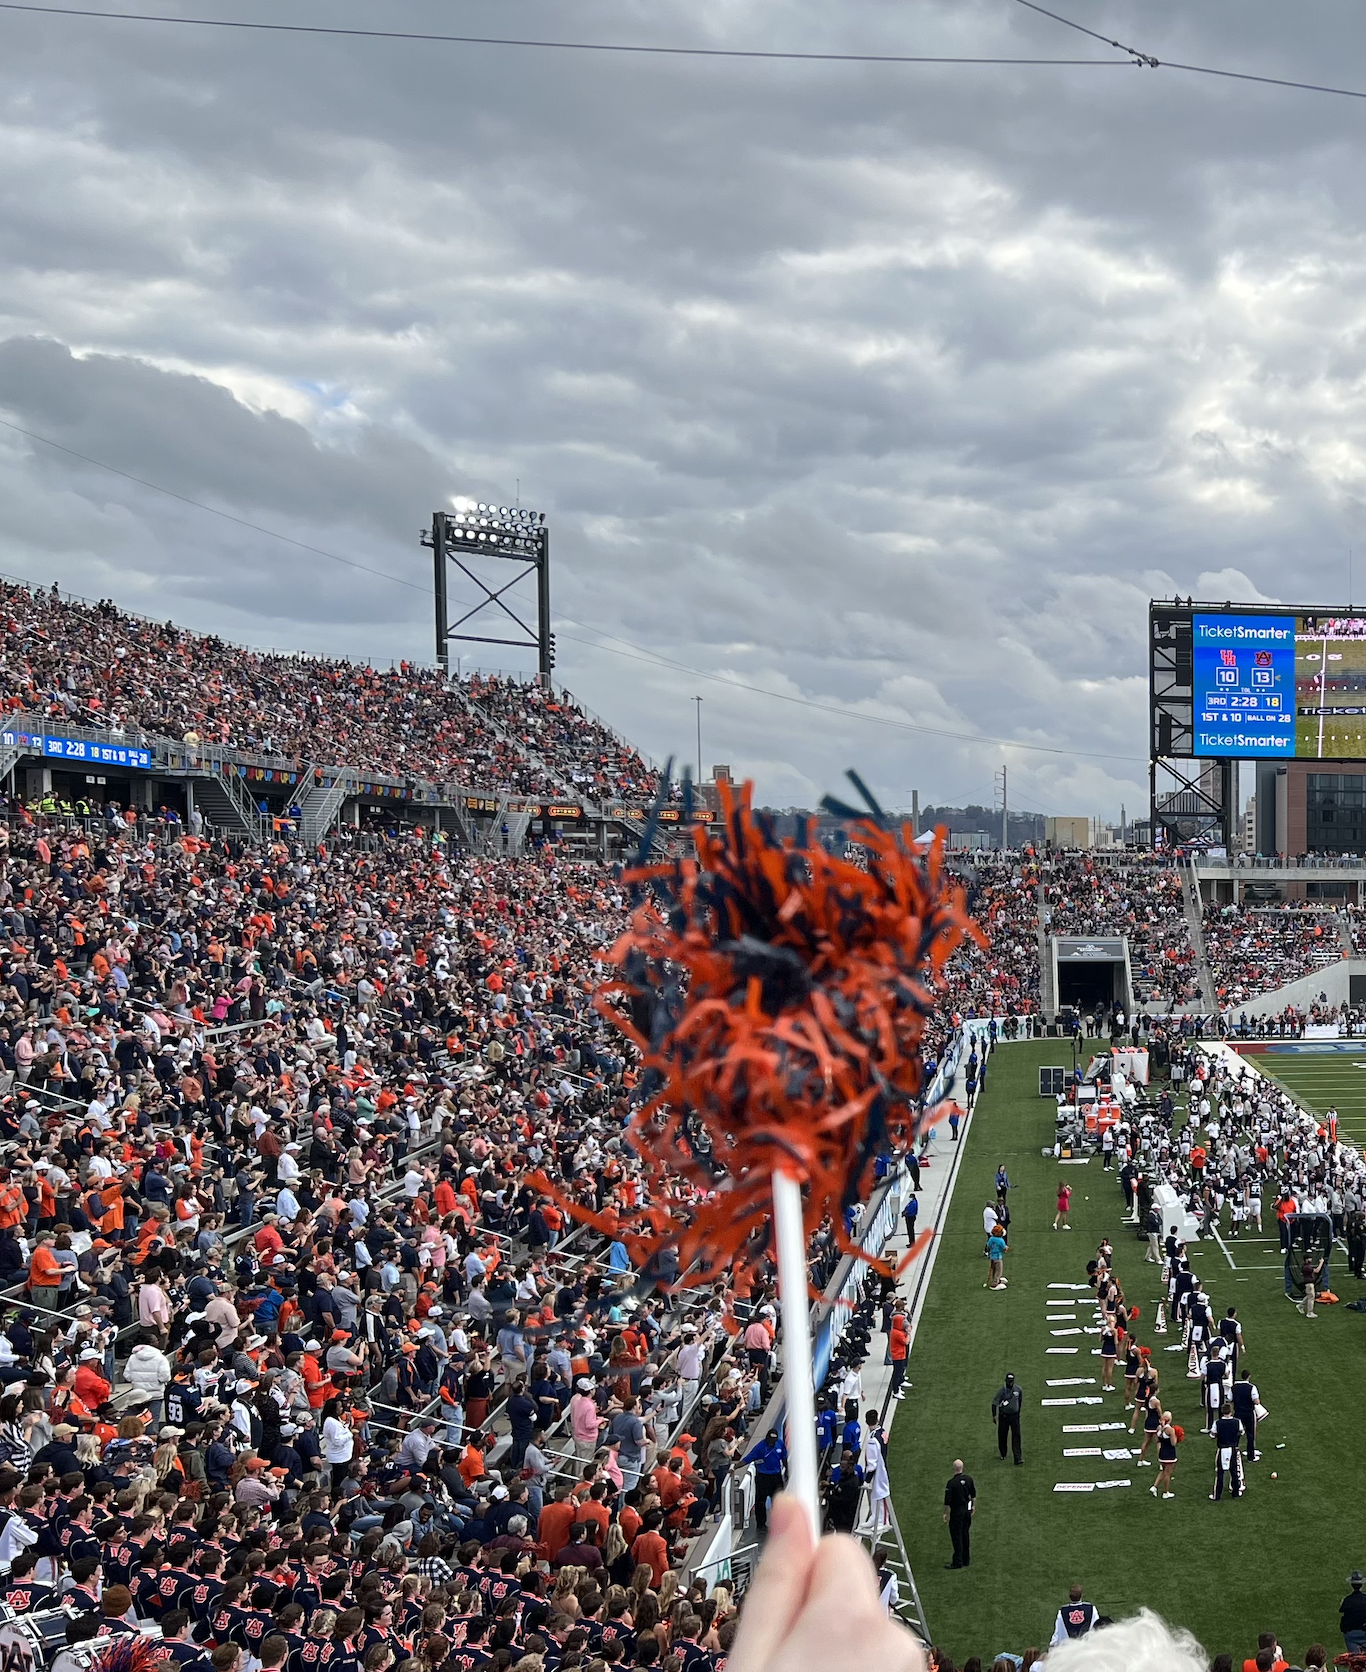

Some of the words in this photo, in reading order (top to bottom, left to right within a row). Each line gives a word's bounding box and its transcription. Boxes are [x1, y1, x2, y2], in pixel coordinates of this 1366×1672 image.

[1199, 625, 1288, 639] TicketSmarter
[1219, 671, 1235, 683] 10
[1255, 672, 1270, 684] 13
[1207, 697, 1226, 706] 3RD
[1230, 697, 1258, 707] 2:28
[1265, 697, 1280, 707] 18
[1200, 712, 1219, 722] 1ST
[1222, 713, 1228, 722] &
[1230, 713, 1242, 722] 10
[1247, 714, 1265, 722] BALL
[1278, 714, 1292, 723] 28
[1199, 733, 1288, 747] TicketSmarter
[48, 740, 63, 754] 3RD
[66, 741, 86, 757] 2:28
[91, 746, 99, 758] 18
[102, 748, 113, 760] 1ST
[118, 750, 126, 762] 10
[139, 752, 148, 765] 28
[168, 1402, 183, 1422] 93
[6, 1589, 32, 1610] AU
